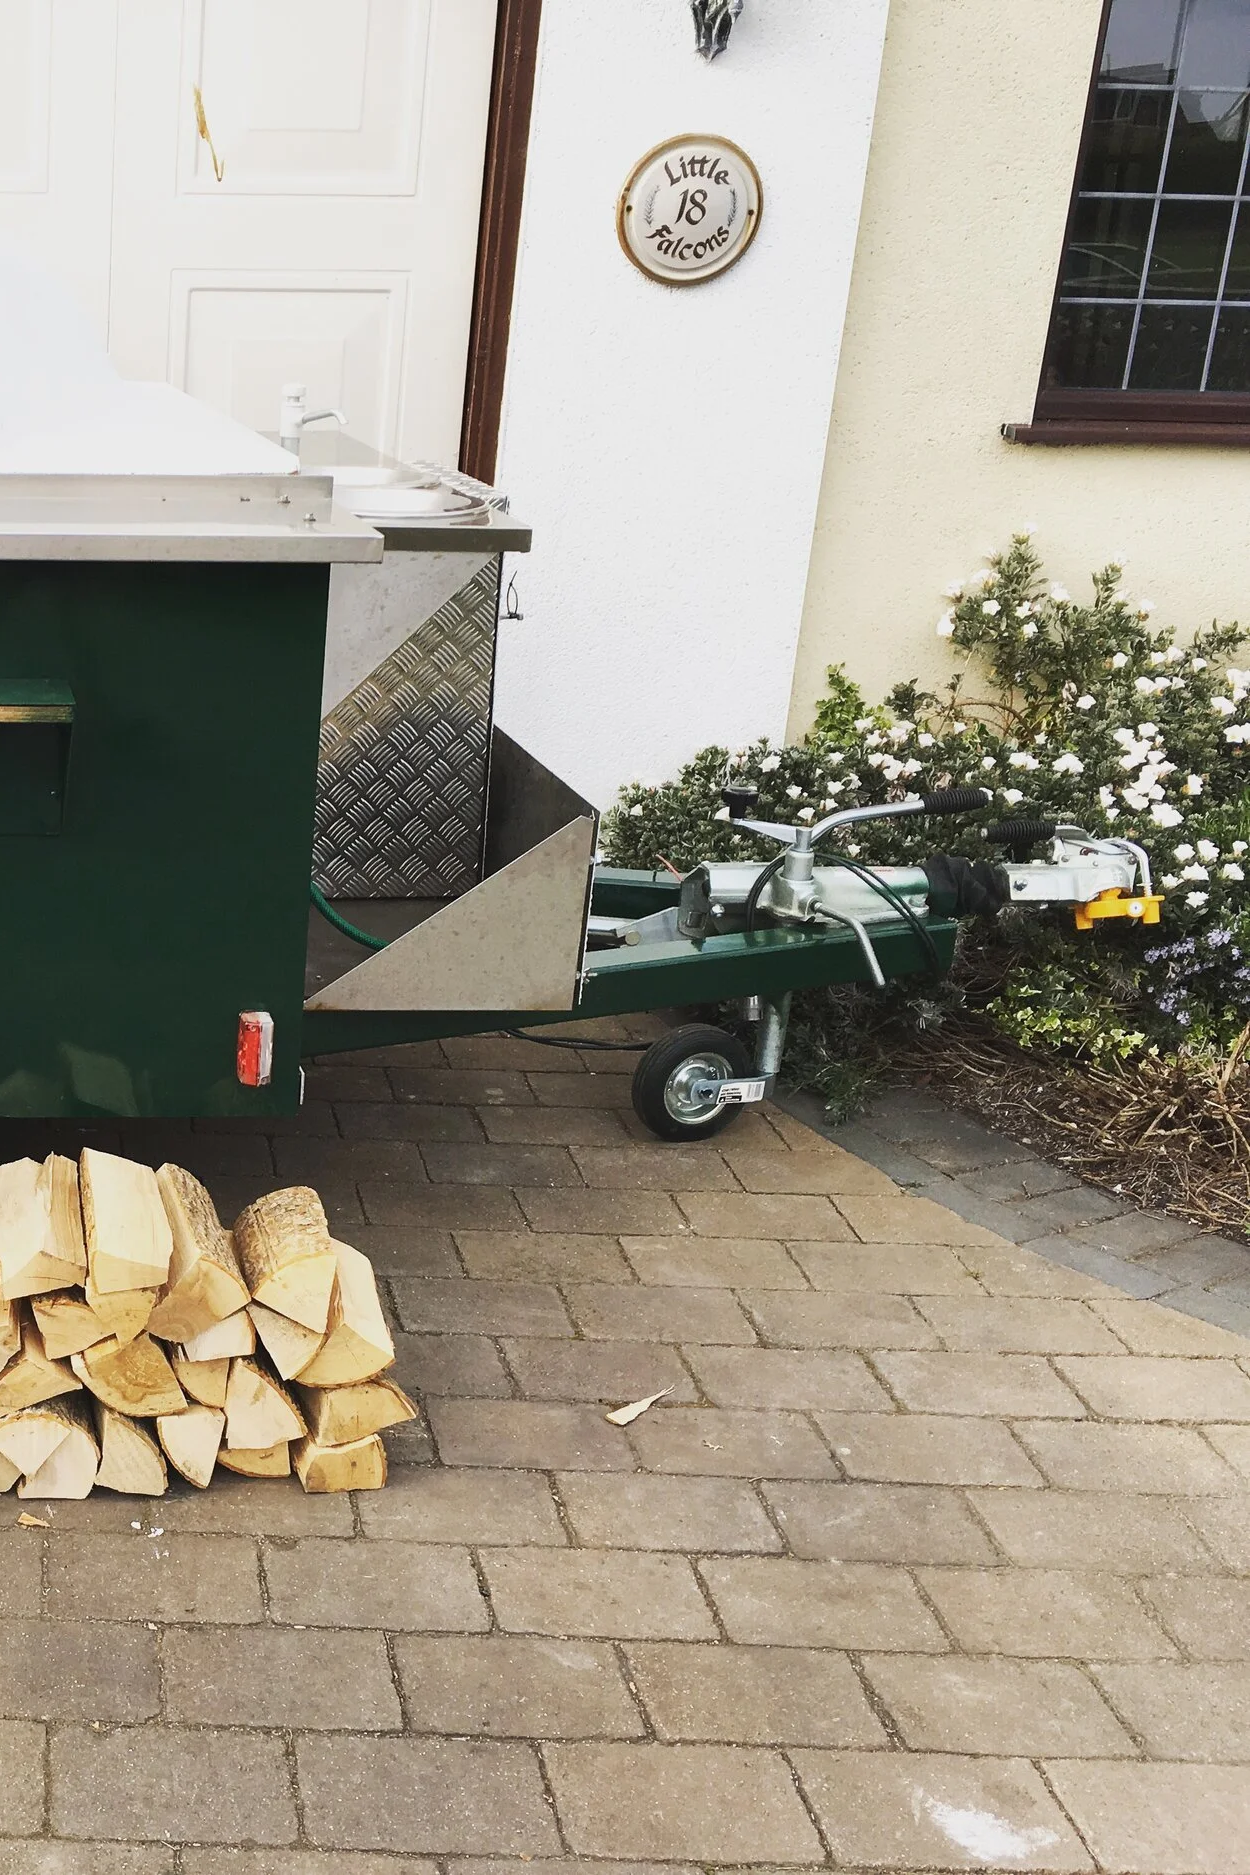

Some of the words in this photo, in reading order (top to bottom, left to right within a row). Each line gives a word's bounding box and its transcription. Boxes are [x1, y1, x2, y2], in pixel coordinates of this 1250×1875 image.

[664, 155, 730, 187] Little
[675, 188, 708, 226] 18
[646, 224, 730, 261] Falcons
